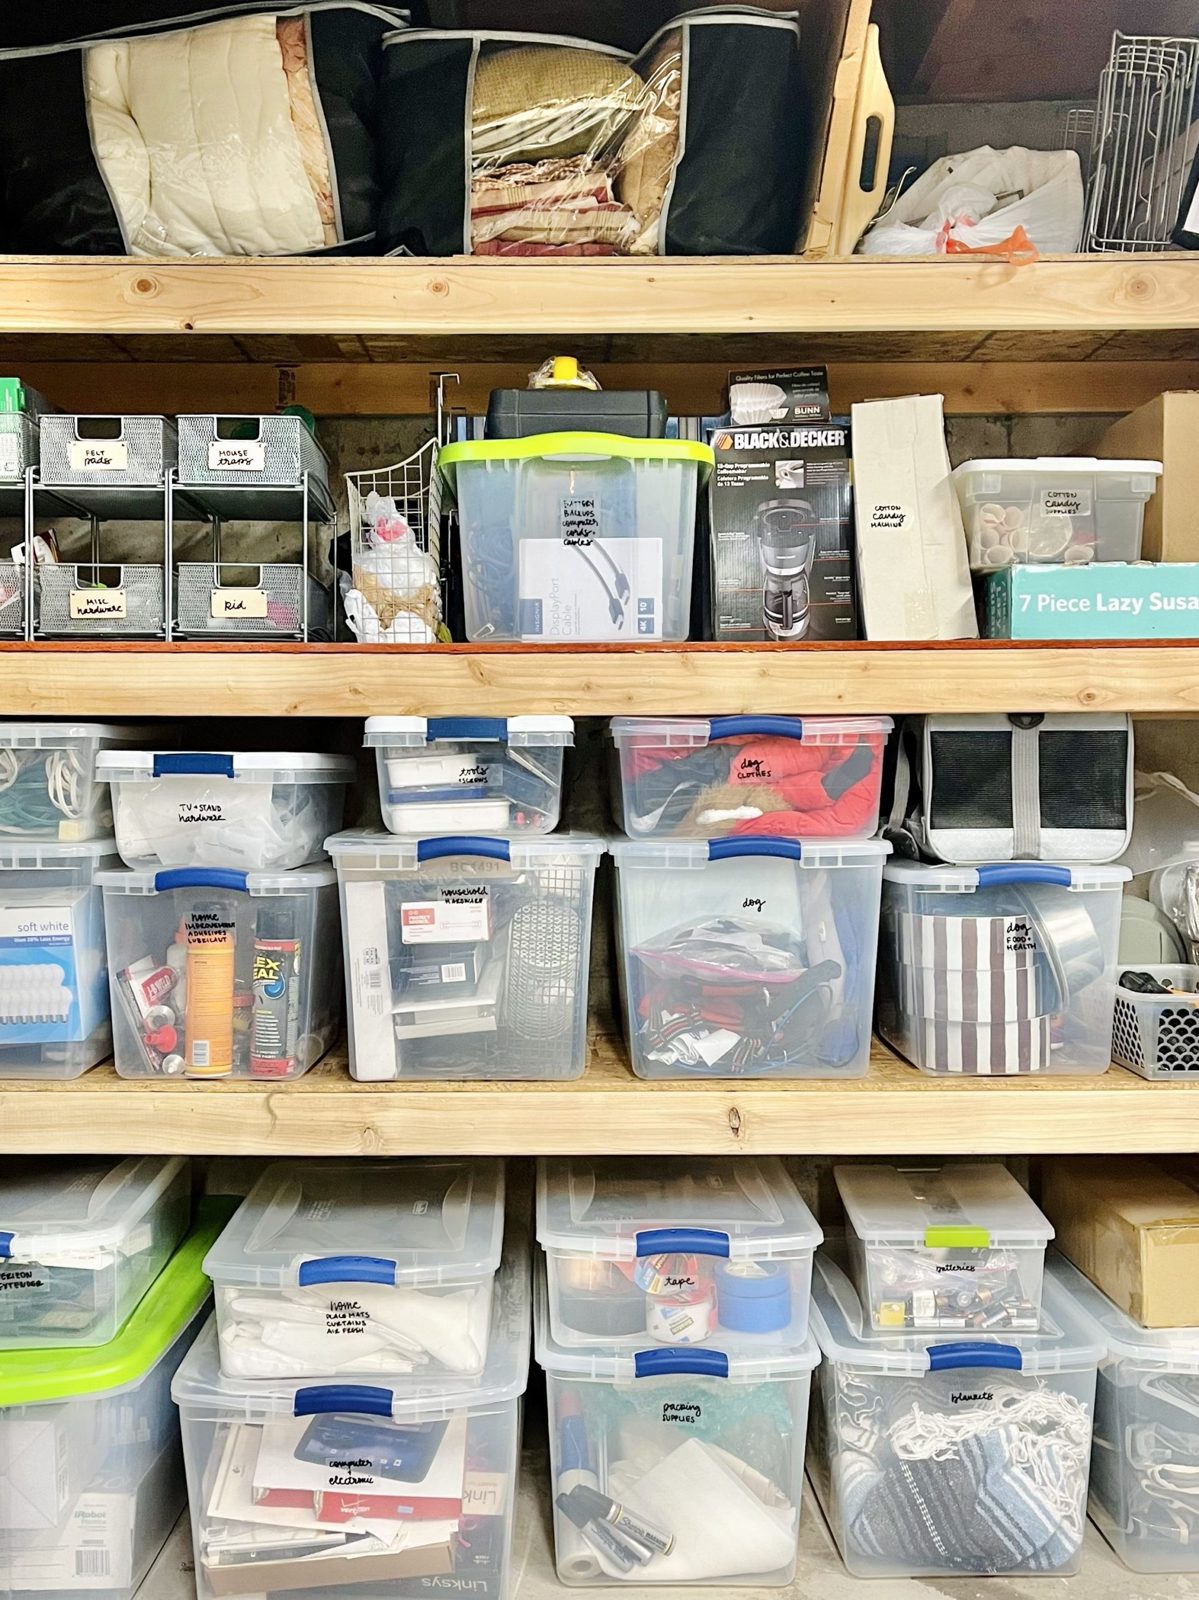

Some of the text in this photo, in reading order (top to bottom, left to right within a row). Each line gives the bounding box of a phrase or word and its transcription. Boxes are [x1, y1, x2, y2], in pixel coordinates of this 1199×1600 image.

[794, 407, 820, 415] BUNN
[84, 456, 112, 466] pads
[217, 457, 254, 466] traps
[872, 513, 906, 523] Candy
[550, 578, 560, 636] DisplayPort
[1019, 592, 1199, 615] 7 Piece Lazy Susa
[78, 605, 122, 615] hardware
[562, 604, 572, 636] Cable
[640, 620, 647, 631] 4K
[741, 758, 764, 771] dog
[737, 770, 771, 779] CLOTHES
[199, 804, 221, 812] STAND
[441, 886, 488, 896] household
[743, 898, 766, 912] dog
[18, 921, 69, 932] soft white
[1007, 922, 1032, 936] dog
[1007, 943, 1036, 951] HEALTH
[254, 956, 280, 971] EX
[253, 968, 279, 979] EAL
[0, 1271, 32, 1280] ERIZON
[664, 1277, 695, 1289] tape
[664, 1402, 701, 1417] packing
[662, 1414, 695, 1423] SUPPLIES
[329, 1459, 372, 1470] computer
[463, 1490, 496, 1504] Link
[422, 1575, 488, 1592] Linksys
